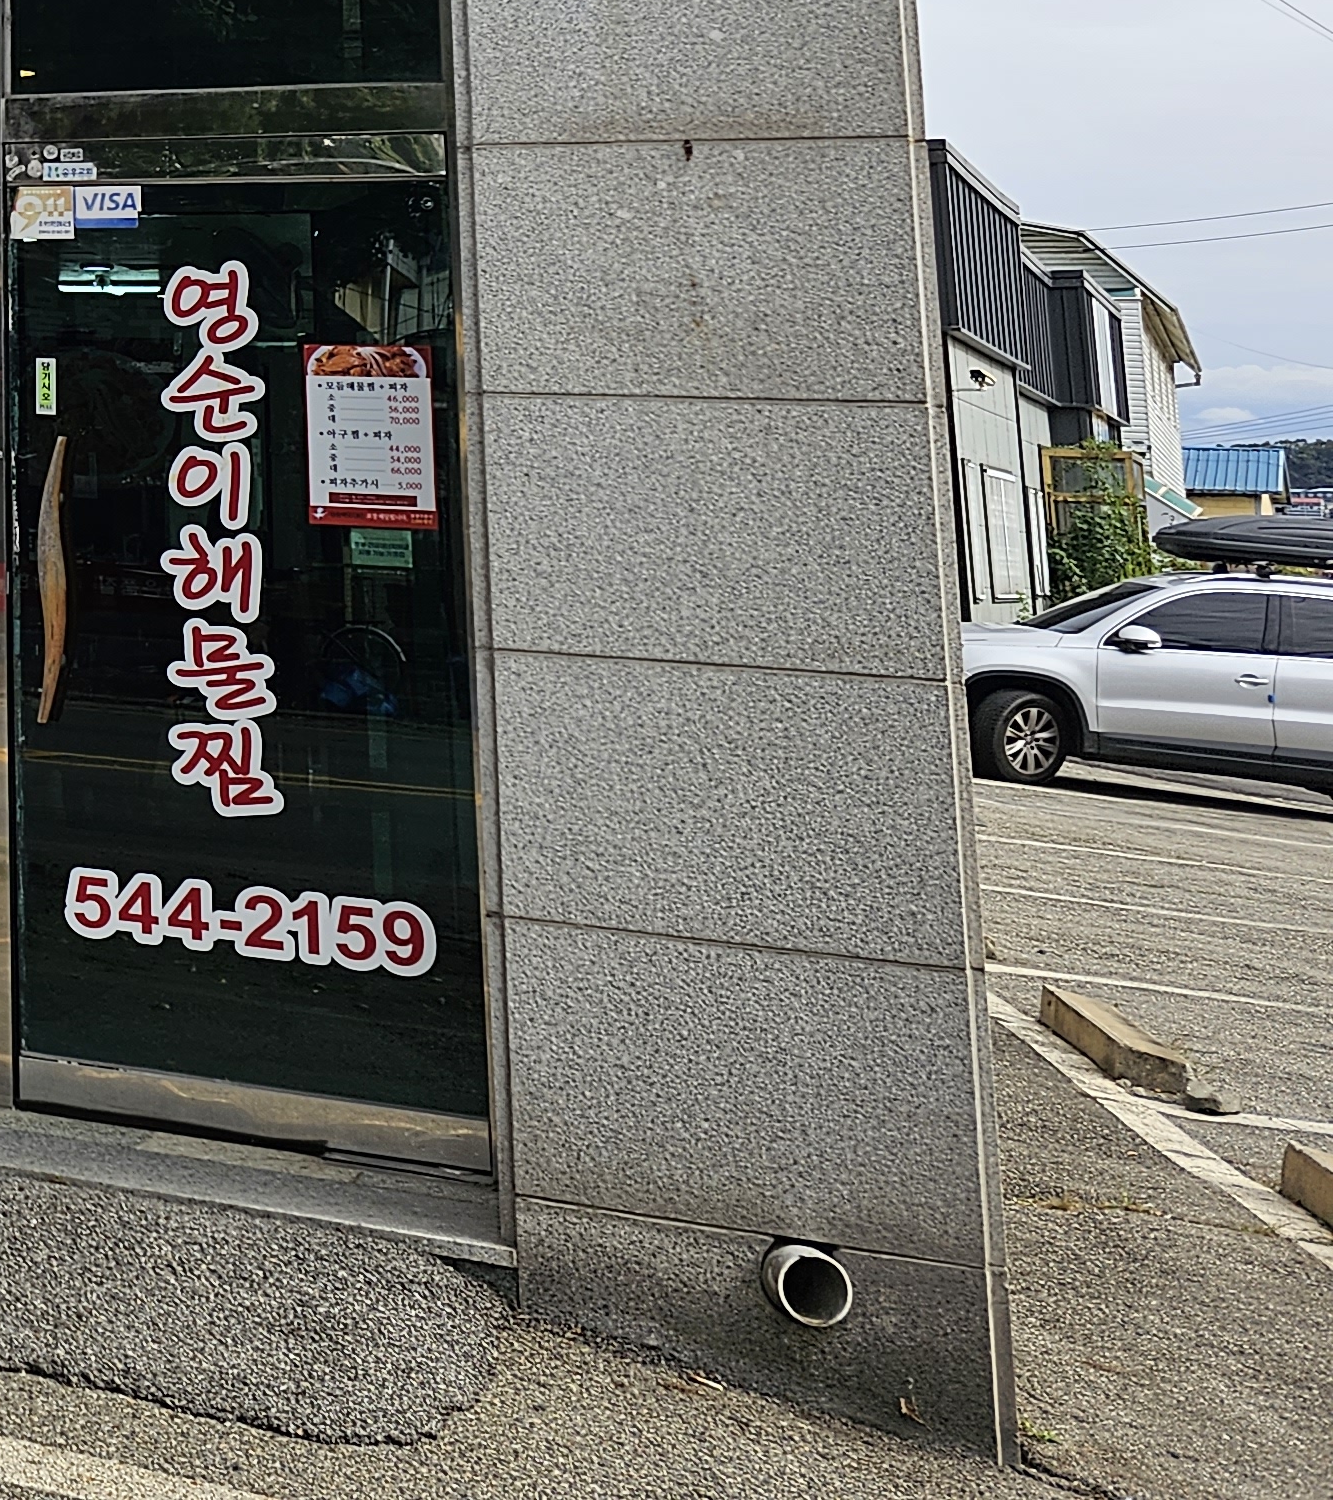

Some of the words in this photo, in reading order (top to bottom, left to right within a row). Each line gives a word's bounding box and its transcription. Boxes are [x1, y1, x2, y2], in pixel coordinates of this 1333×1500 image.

[83, 192, 138, 211] VISA
[41, 361, 51, 401] 당기시오
[388, 382, 408, 392] 피자
[387, 395, 419, 404] 46,000
[389, 406, 419, 415] 56,000
[389, 417, 420, 425] 70,000
[373, 430, 392, 440] 피자
[389, 445, 421, 453] 44,000
[390, 456, 421, 465] 54,000
[391, 467, 422, 476] 66,000
[398, 482, 422, 490] 5,000
[69, 871, 431, 972] 544-2159
